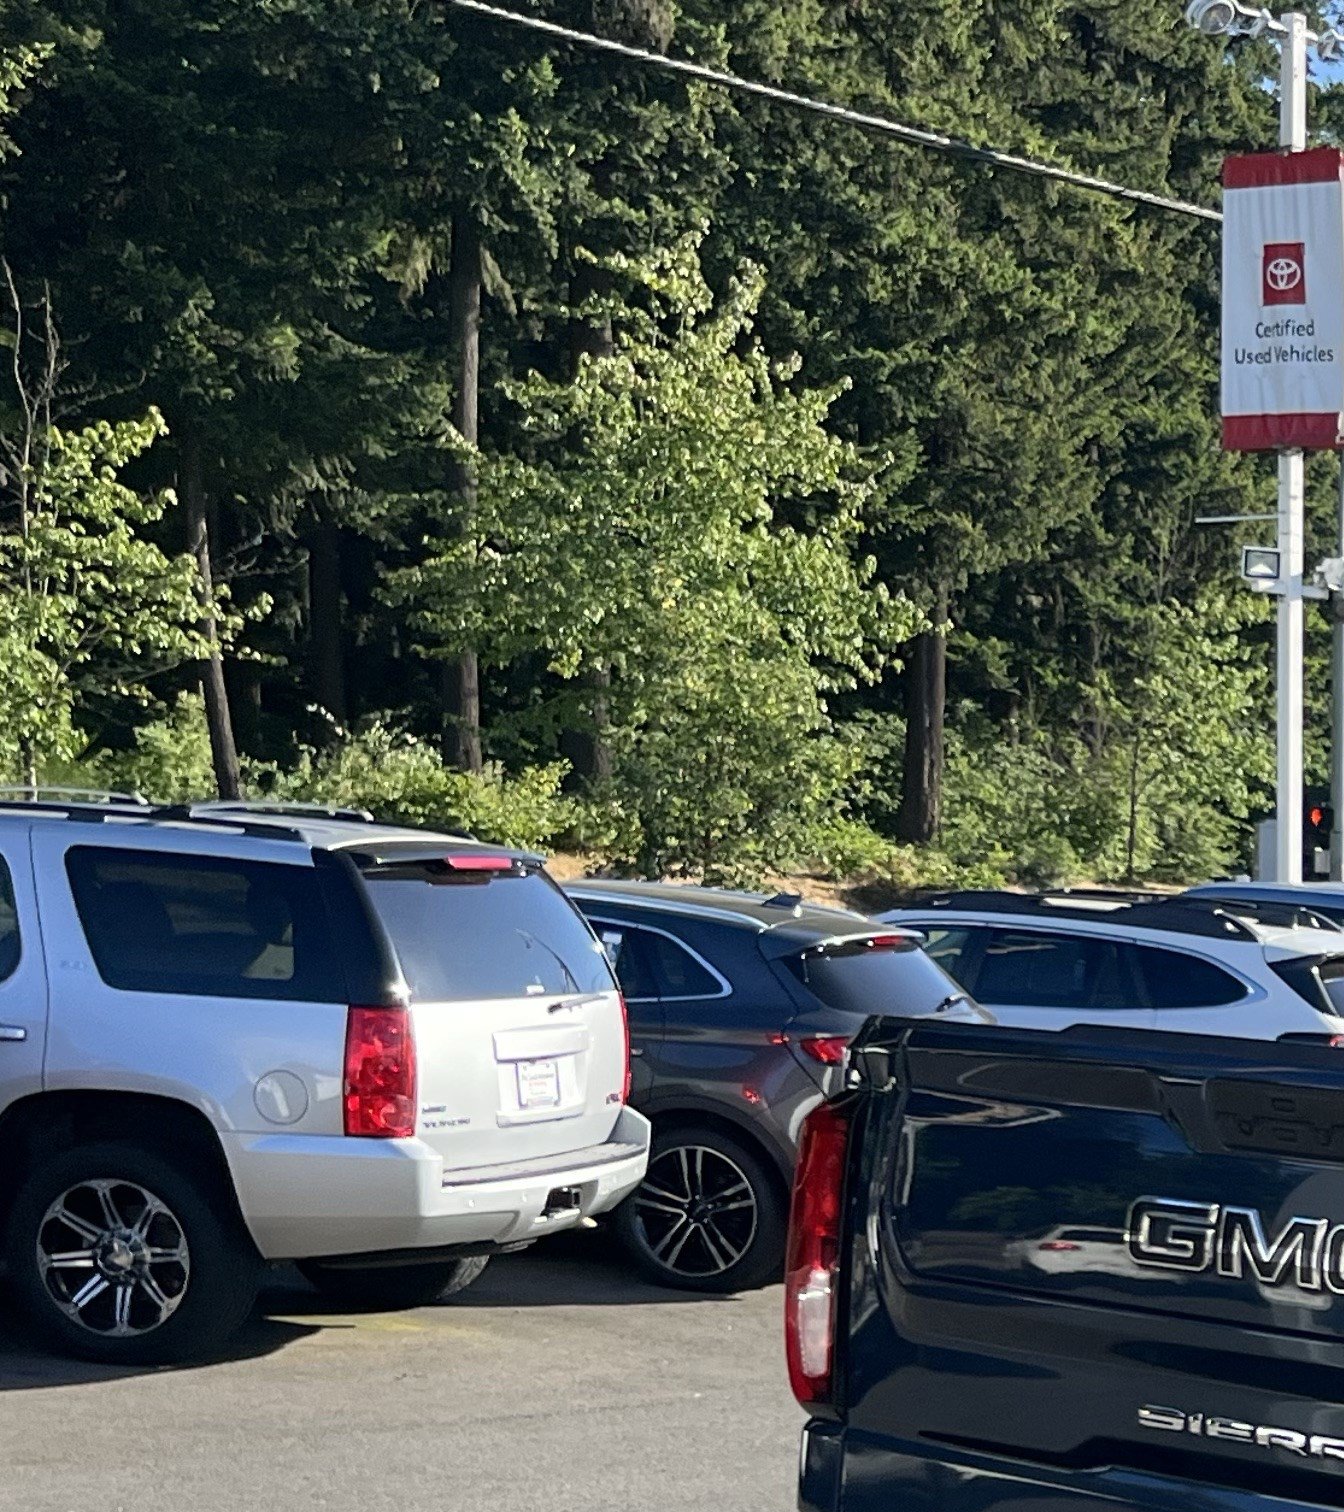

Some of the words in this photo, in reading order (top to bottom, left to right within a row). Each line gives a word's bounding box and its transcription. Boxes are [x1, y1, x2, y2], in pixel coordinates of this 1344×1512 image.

[1255, 319, 1315, 338] Certified
[1235, 346, 1271, 365] Used
[1274, 344, 1334, 363] Vehicles
